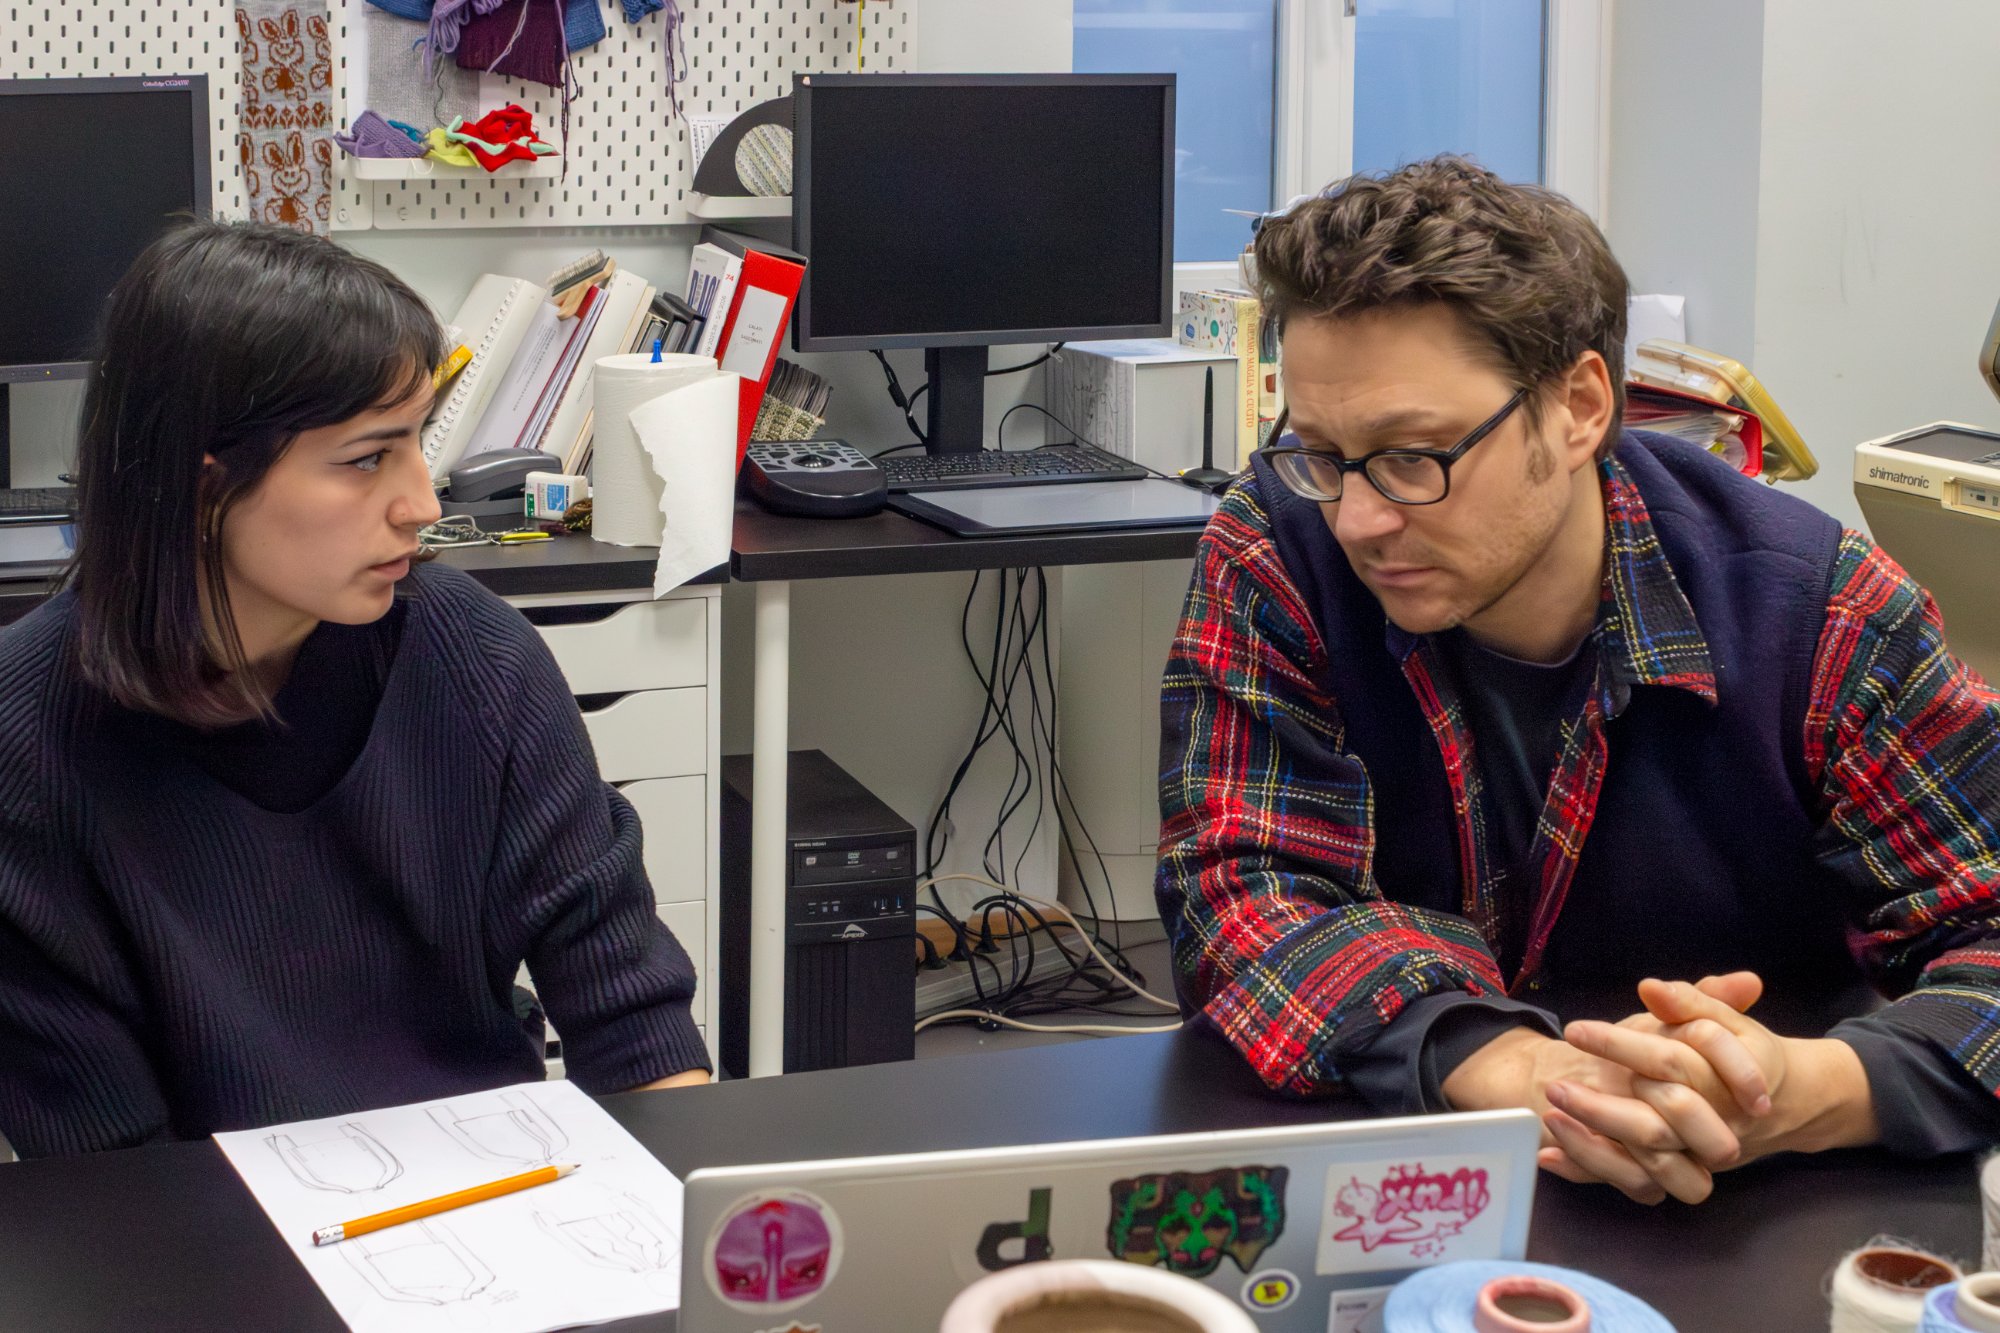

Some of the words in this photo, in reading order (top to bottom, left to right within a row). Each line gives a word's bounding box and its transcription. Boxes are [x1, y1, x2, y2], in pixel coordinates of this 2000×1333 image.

[725, 273, 735, 282] 74
[1246, 357, 1255, 388] MAGLIA
[1245, 398, 1255, 428] CUCITO
[1869, 466, 1930, 489] shimatronic
